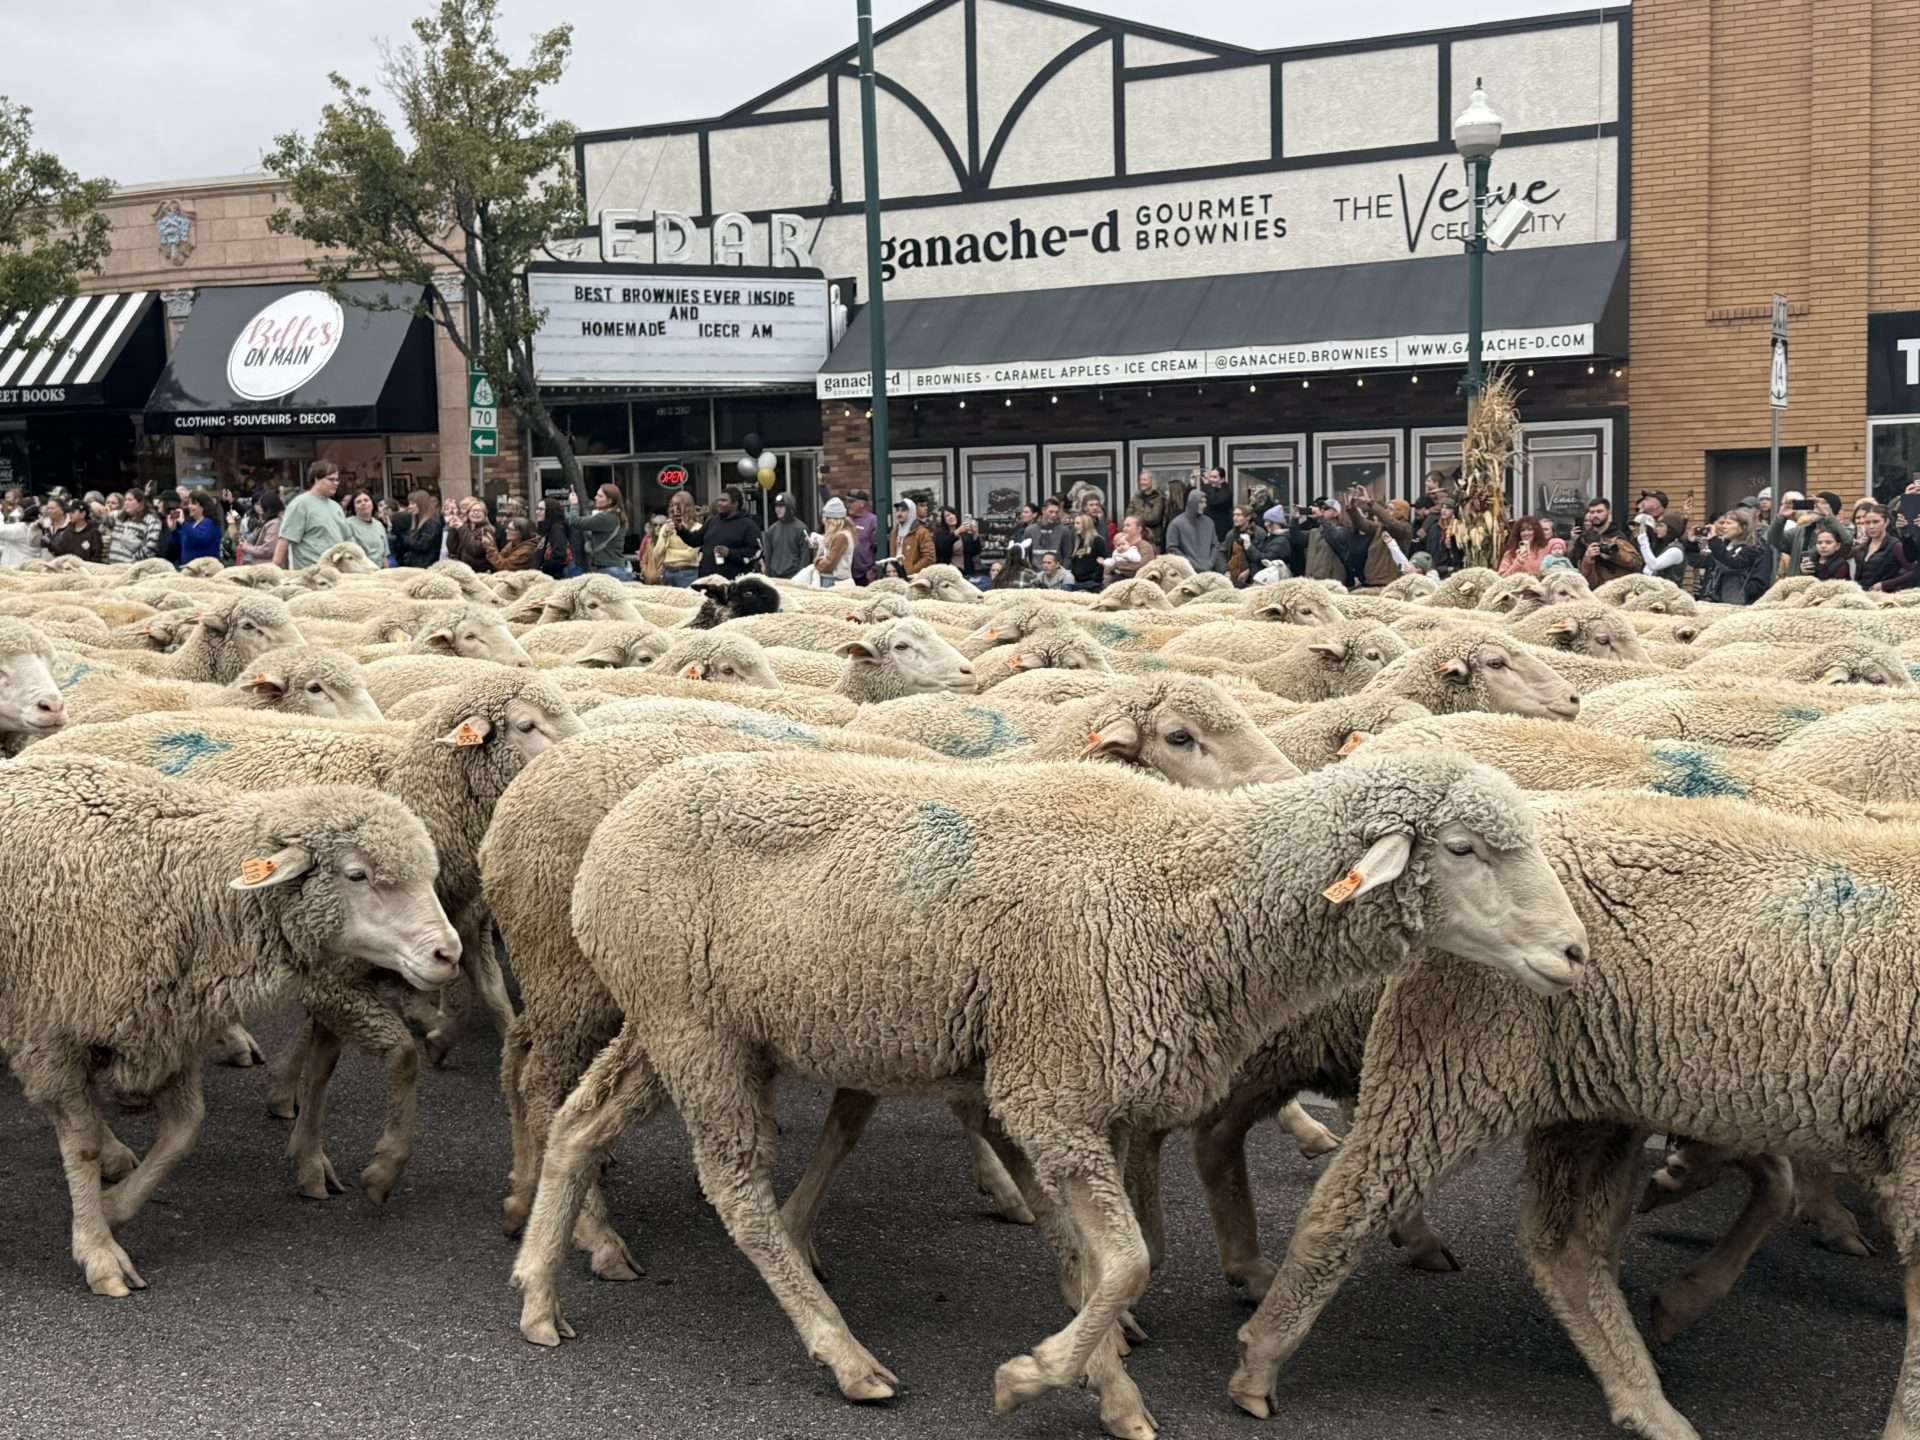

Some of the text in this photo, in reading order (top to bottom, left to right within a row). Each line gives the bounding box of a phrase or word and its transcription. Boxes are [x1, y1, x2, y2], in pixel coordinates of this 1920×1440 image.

[1136, 194, 1273, 226] GOURMET
[1333, 162, 1560, 253] THE Veue
[1136, 217, 1287, 250] BROWNIES
[1519, 213, 1566, 234] ITY
[545, 208, 813, 268] EDAR
[880, 208, 1121, 281] ganache-d
[575, 285, 795, 306] BEST BROWNIES EVER INSIDE
[669, 306, 699, 320] AND
[582, 321, 666, 337] HOMEMADE
[243, 345, 314, 366] ON MAIN
[1408, 334, 1585, 356] WWW.GACHE-D.COM
[1215, 346, 1388, 369] @GANACHED.BROWNIES
[824, 372, 900, 392] ganac-d
[917, 358, 1198, 387] BROWNIES CARAMEL APPLES ICE CREAM
[22, 388, 65, 402] BOOKS
[175, 413, 336, 428] CLOTHING SOUVENIRS DECOR
[475, 410, 492, 425] 70
[660, 470, 686, 484] OPEN
